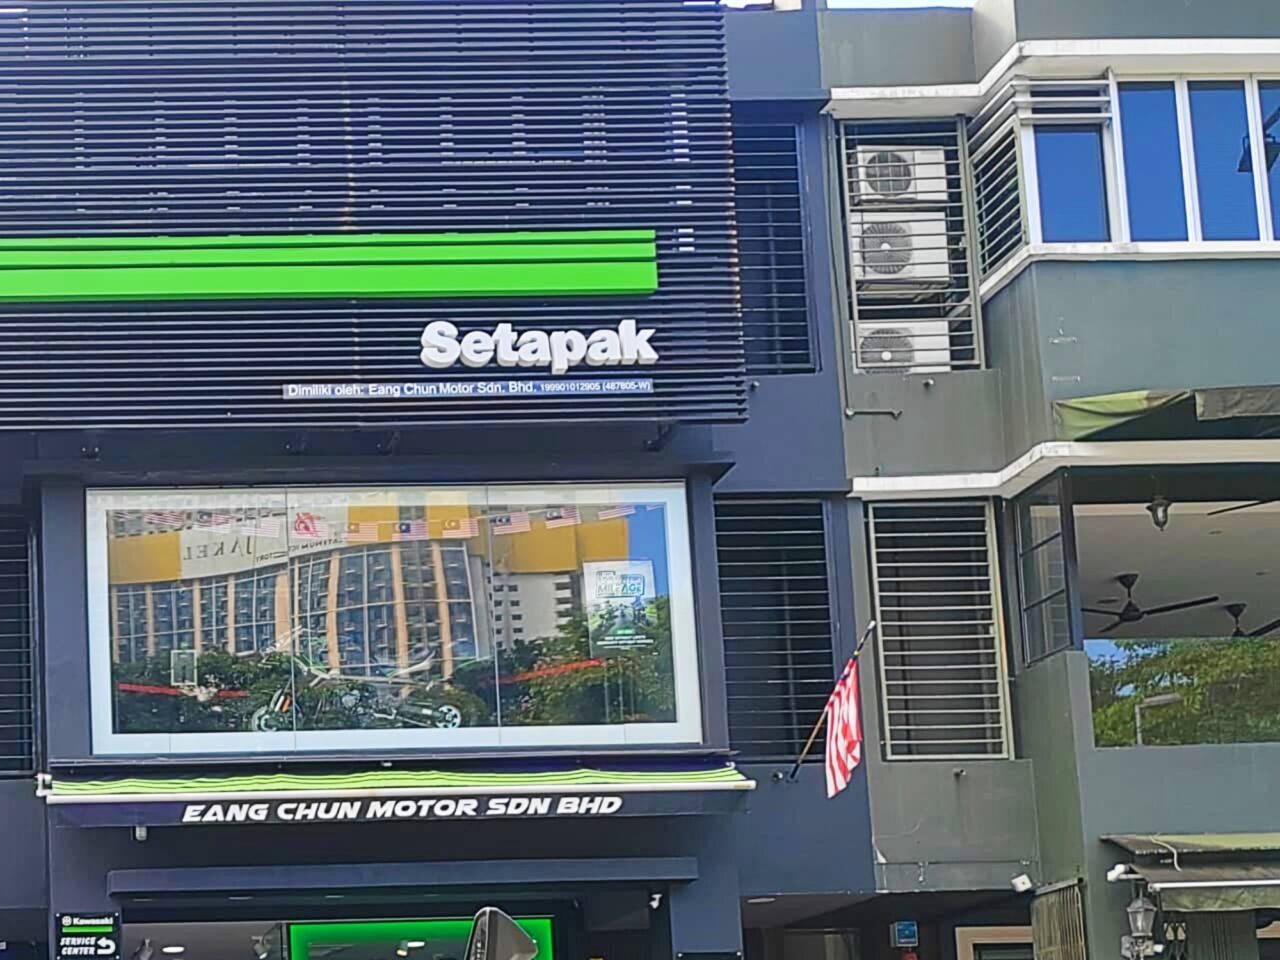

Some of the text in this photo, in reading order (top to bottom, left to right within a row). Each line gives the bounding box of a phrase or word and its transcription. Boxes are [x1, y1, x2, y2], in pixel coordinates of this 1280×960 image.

[420, 319, 658, 374] Setapak
[288, 384, 332, 396] Dimiliki
[334, 384, 364, 396] oleh:
[369, 384, 400, 397] Eang
[404, 383, 437, 394] Chun
[439, 383, 474, 394] Motor
[477, 382, 505, 393] Sdn.
[509, 381, 537, 393] Bhd.
[182, 796, 622, 822] EANG CHUN MOTOR SDN BHD
[73, 917, 113, 925] Kawasaki
[60, 937, 96, 946] SERVICE
[61, 947, 95, 955] CENTER
